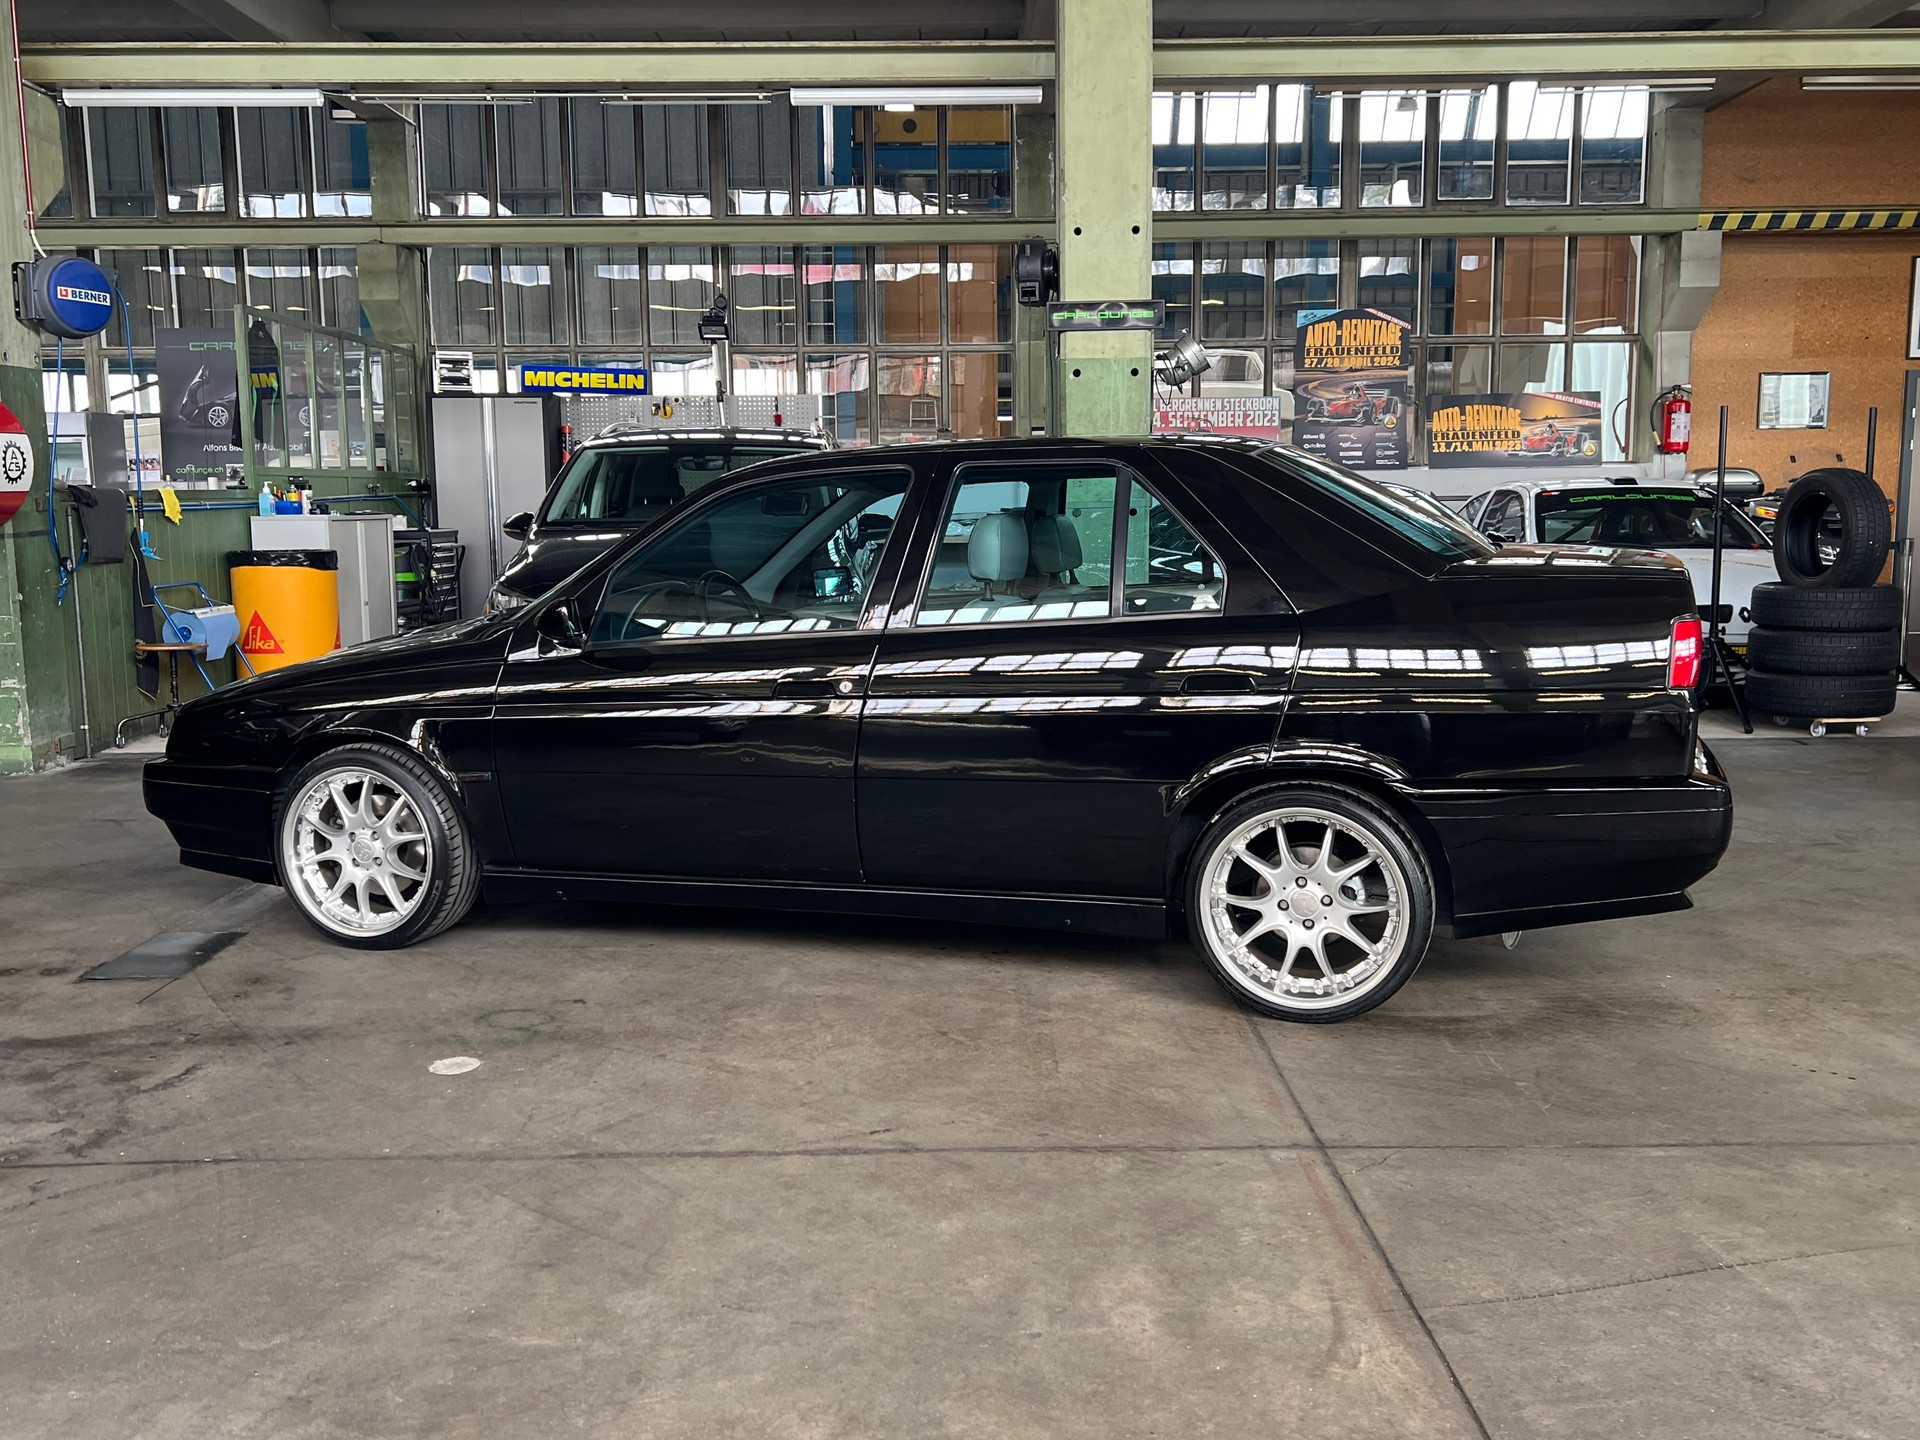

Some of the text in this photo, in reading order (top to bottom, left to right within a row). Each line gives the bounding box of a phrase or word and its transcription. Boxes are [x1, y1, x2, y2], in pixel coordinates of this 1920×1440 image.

[71, 289, 108, 303] BERNER
[1052, 311, 1154, 319] CARLOUNGE
[1305, 319, 1402, 346] AUTO-RENNTAGE
[1306, 347, 1400, 356] FRAUENFELD
[1373, 356, 1400, 367] 2024
[524, 371, 645, 389] MICHELIN
[1160, 398, 1221, 412] BERGRENNEN
[1224, 397, 1279, 411] STECKBORN
[1246, 411, 1279, 427] 2023
[1432, 404, 1522, 432] AUTO-RENNTAGE
[1433, 430, 1521, 441] FRAUENFELD
[1495, 440, 1521, 451] 2023
[1569, 493, 1696, 503] CARLOUNGE
[245, 626, 275, 650] Sika
